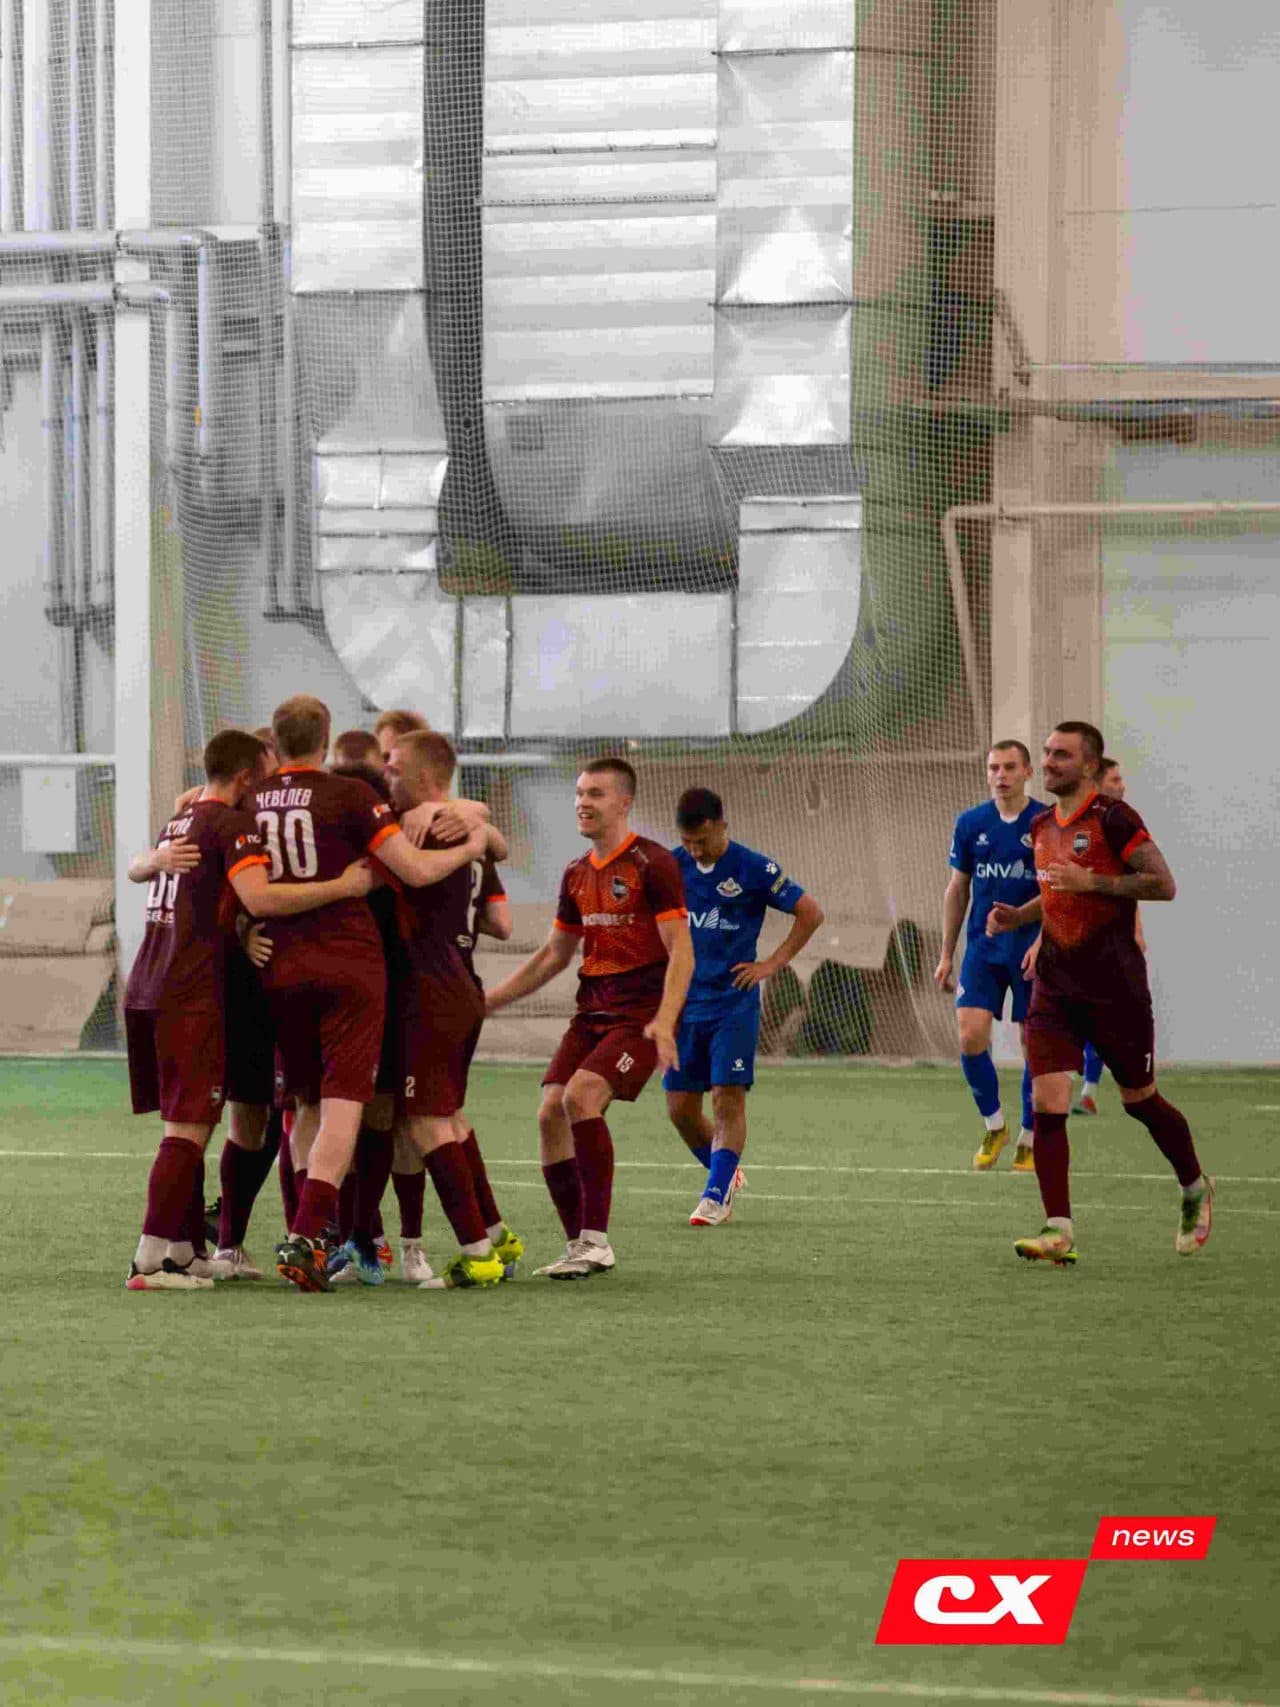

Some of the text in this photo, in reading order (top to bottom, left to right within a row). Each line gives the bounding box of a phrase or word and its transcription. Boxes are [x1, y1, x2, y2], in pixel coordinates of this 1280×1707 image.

[256, 809, 318, 881] 30
[976, 863, 1011, 878] GNV
[615, 1051, 635, 1073] 15
[405, 1075, 416, 1098] 2
